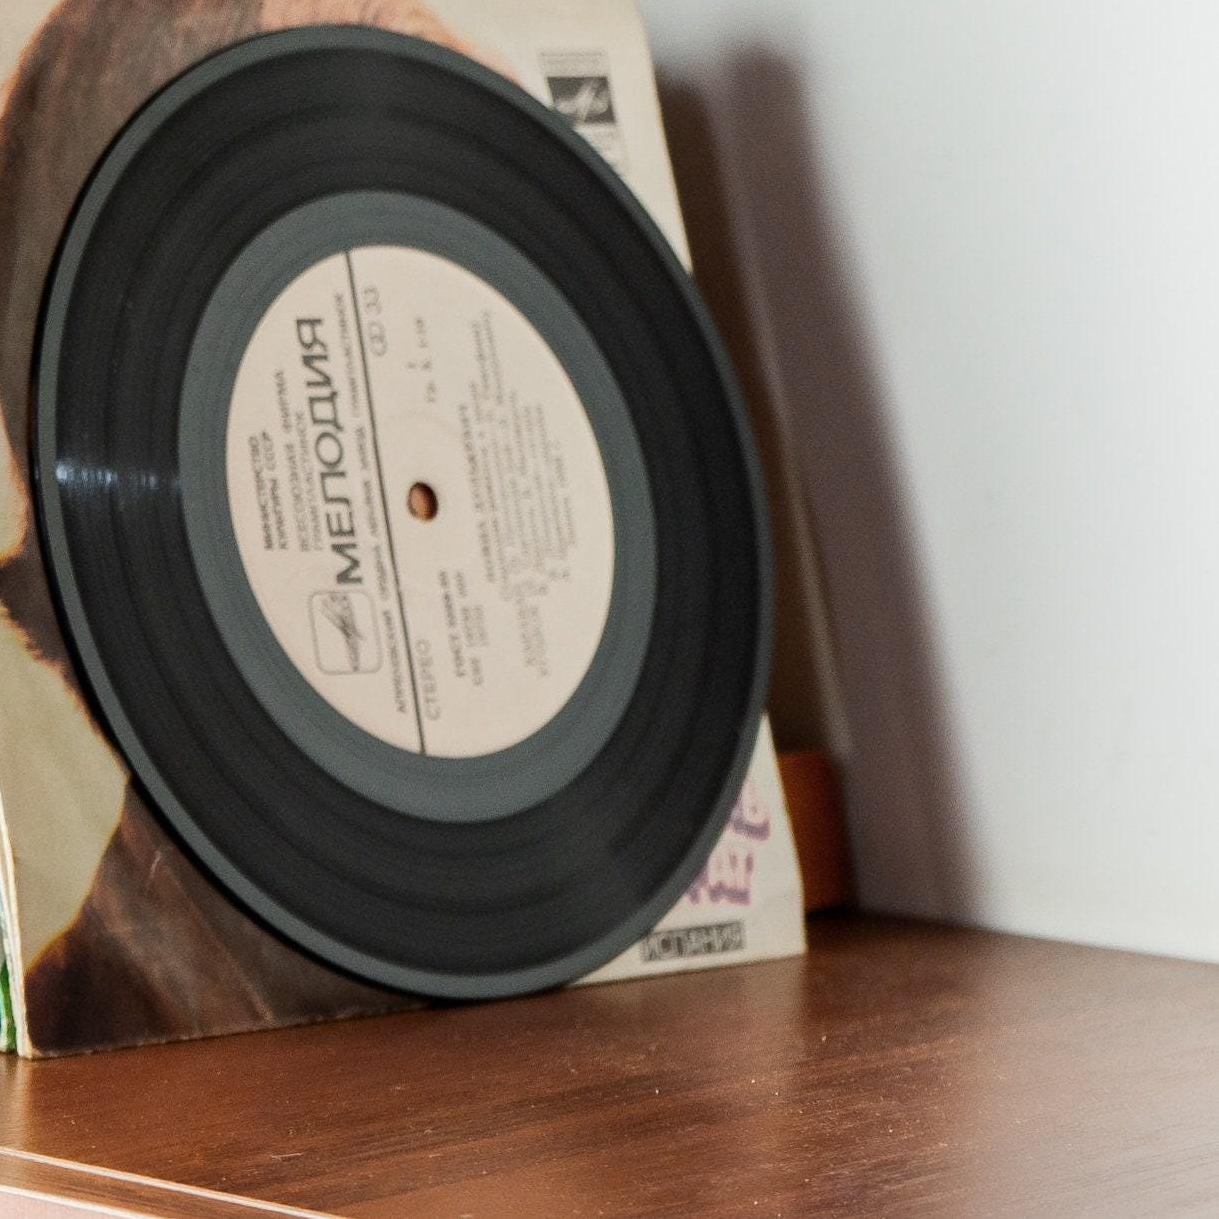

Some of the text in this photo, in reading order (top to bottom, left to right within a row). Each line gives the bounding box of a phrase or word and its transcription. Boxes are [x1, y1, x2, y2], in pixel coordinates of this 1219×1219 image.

[260, 431, 276, 471] СССР
[296, 317, 365, 586] МЕЛОДИЯ
[414, 639, 442, 721] СТЕРЕО
